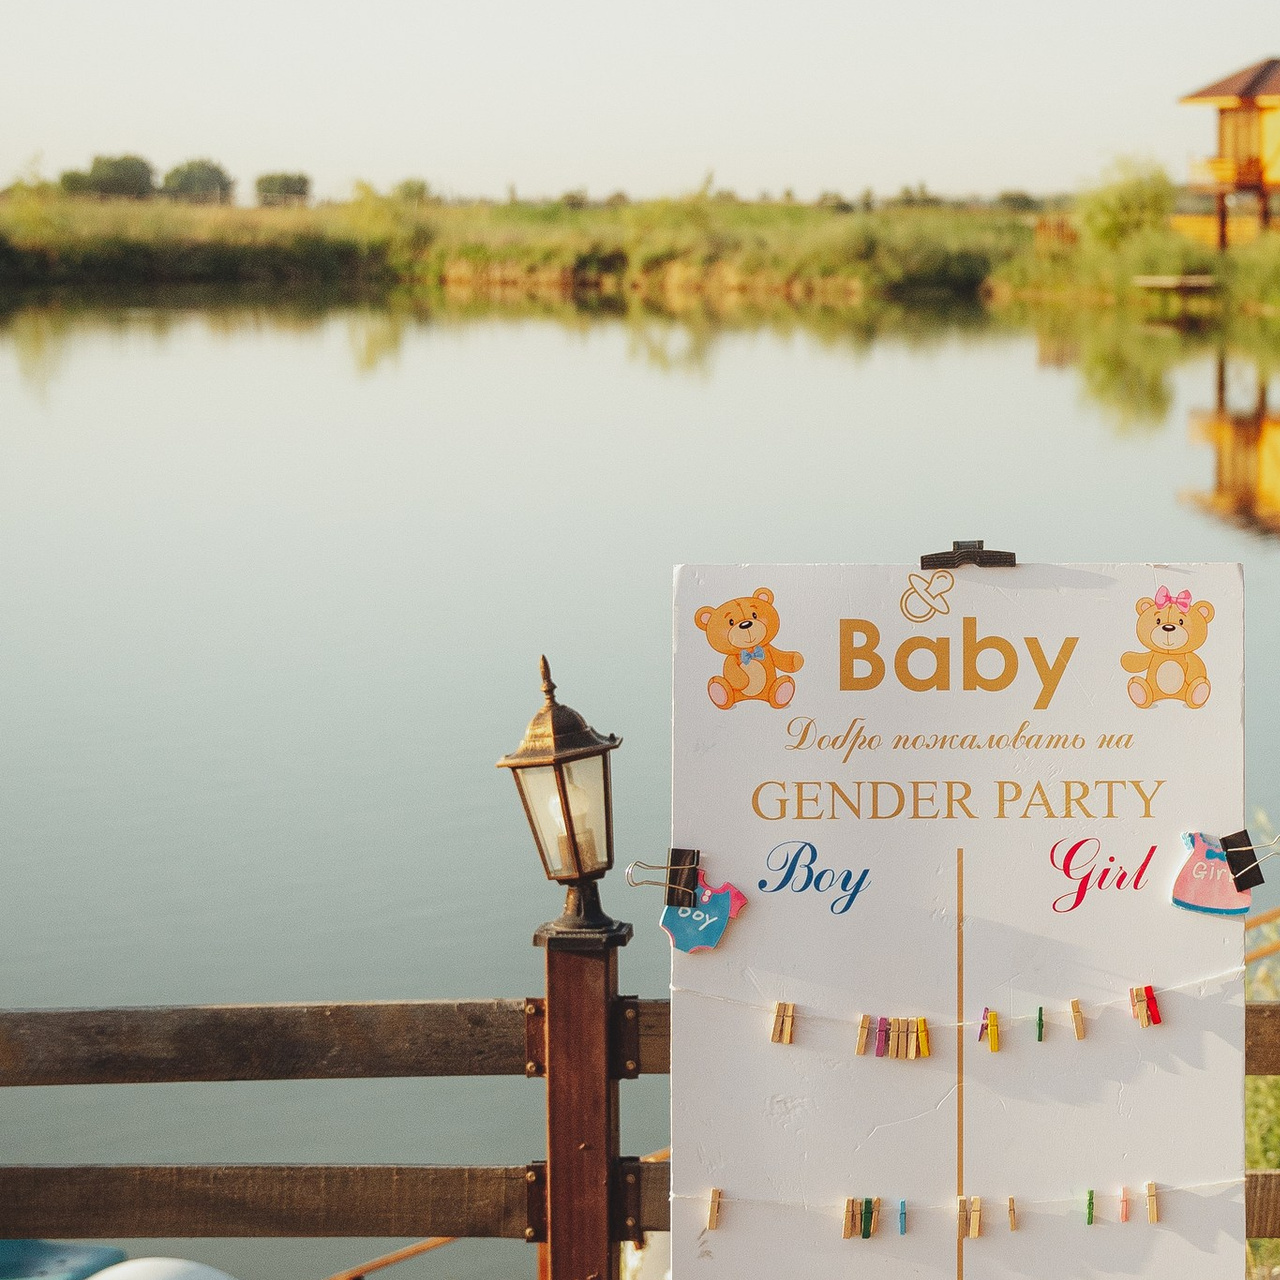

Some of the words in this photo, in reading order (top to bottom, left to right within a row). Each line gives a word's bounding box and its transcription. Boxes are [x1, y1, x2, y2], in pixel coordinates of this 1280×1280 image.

[839, 616, 1080, 710] Baby
[784, 716, 883, 764] Добро
[892, 720, 1087, 751] пожаловать
[1097, 733, 1135, 750] на
[751, 780, 977, 821] GENDER
[994, 779, 1168, 820] PARTY
[757, 840, 872, 915] Boy
[1049, 837, 1158, 913] Girl
